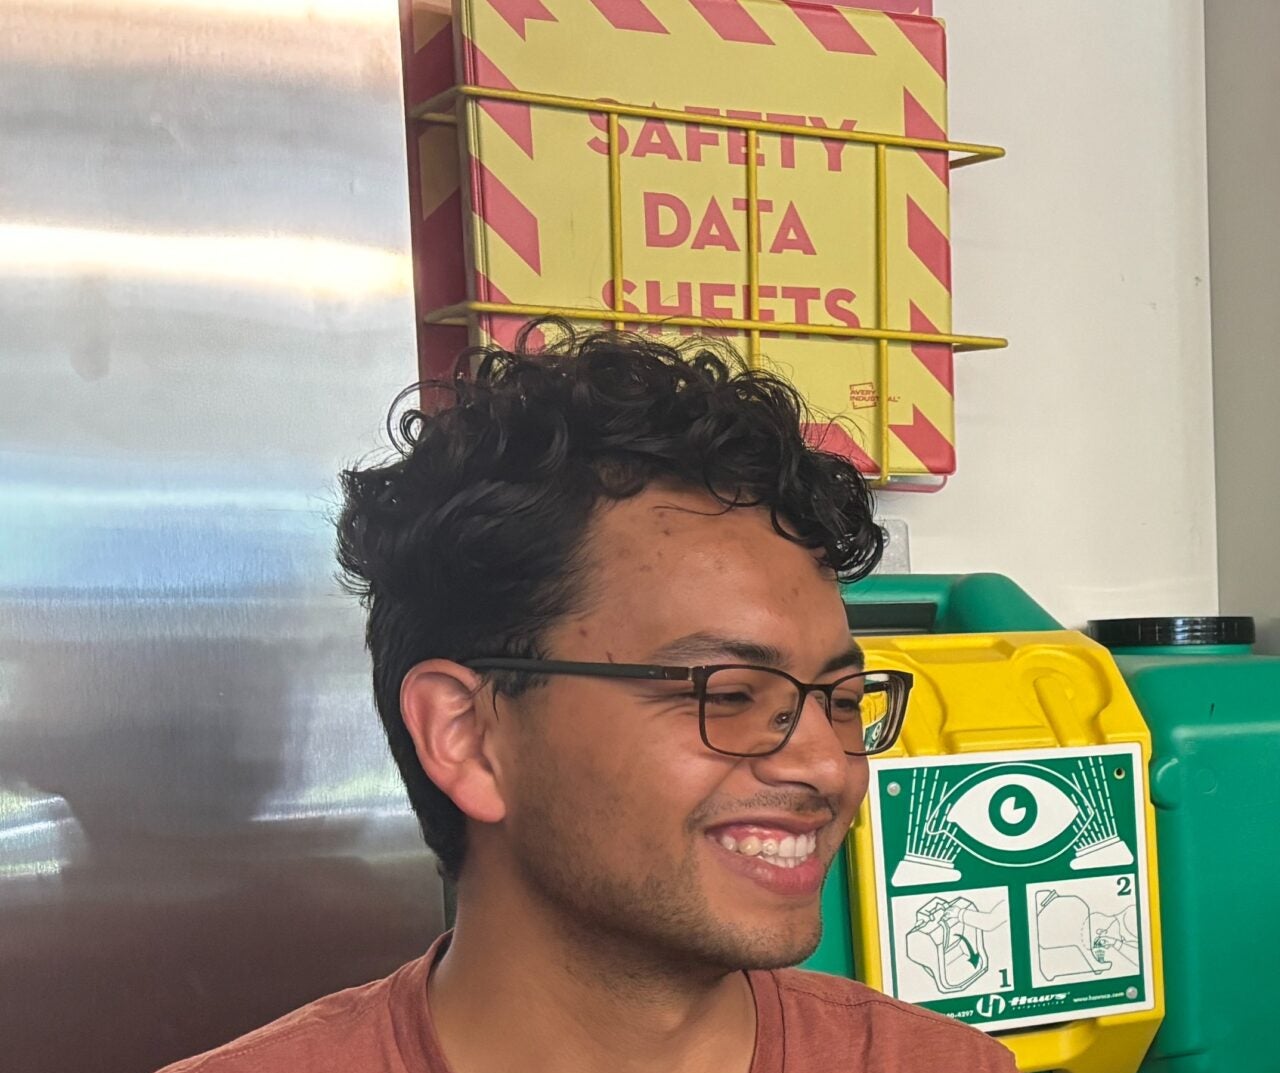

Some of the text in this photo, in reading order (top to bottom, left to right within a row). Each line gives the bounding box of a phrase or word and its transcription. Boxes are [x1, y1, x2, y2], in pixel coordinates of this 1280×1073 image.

[587, 98, 858, 172] SAFETY
[643, 191, 817, 256] DATA
[601, 278, 861, 342] SHEETS
[1116, 876, 1132, 897] 2
[998, 968, 1012, 988] 1
